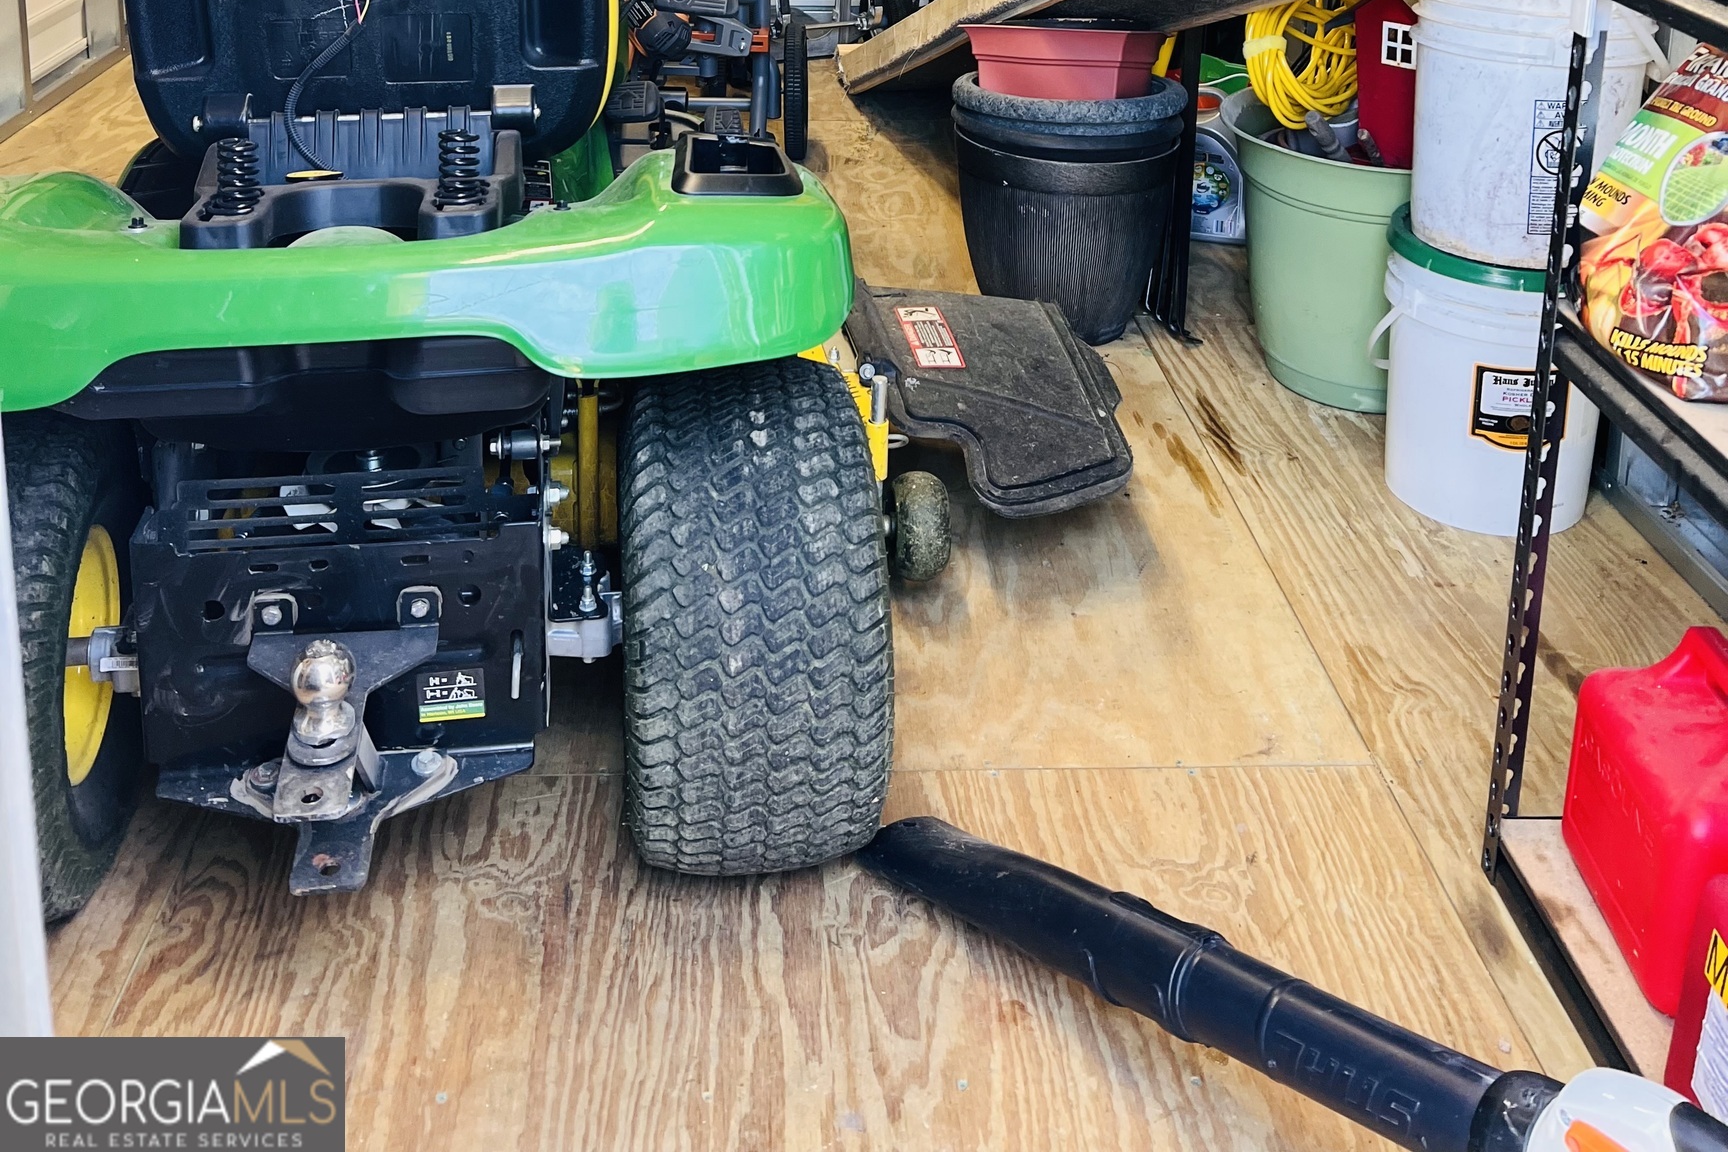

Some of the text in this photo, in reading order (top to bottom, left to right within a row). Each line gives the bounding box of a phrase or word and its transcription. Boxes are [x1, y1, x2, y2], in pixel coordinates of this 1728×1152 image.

[1680, 105, 1718, 128] GROUND
[1616, 120, 1679, 160] MONTH
[1599, 180, 1632, 206] MOUNDS
[1610, 328, 1709, 363] KILLS MOUNDS
[1623, 349, 1640, 366] 15
[1640, 352, 1704, 378] MINUTES
[1492, 375, 1519, 386] Hans
[1502, 395, 1533, 404] PICKL
